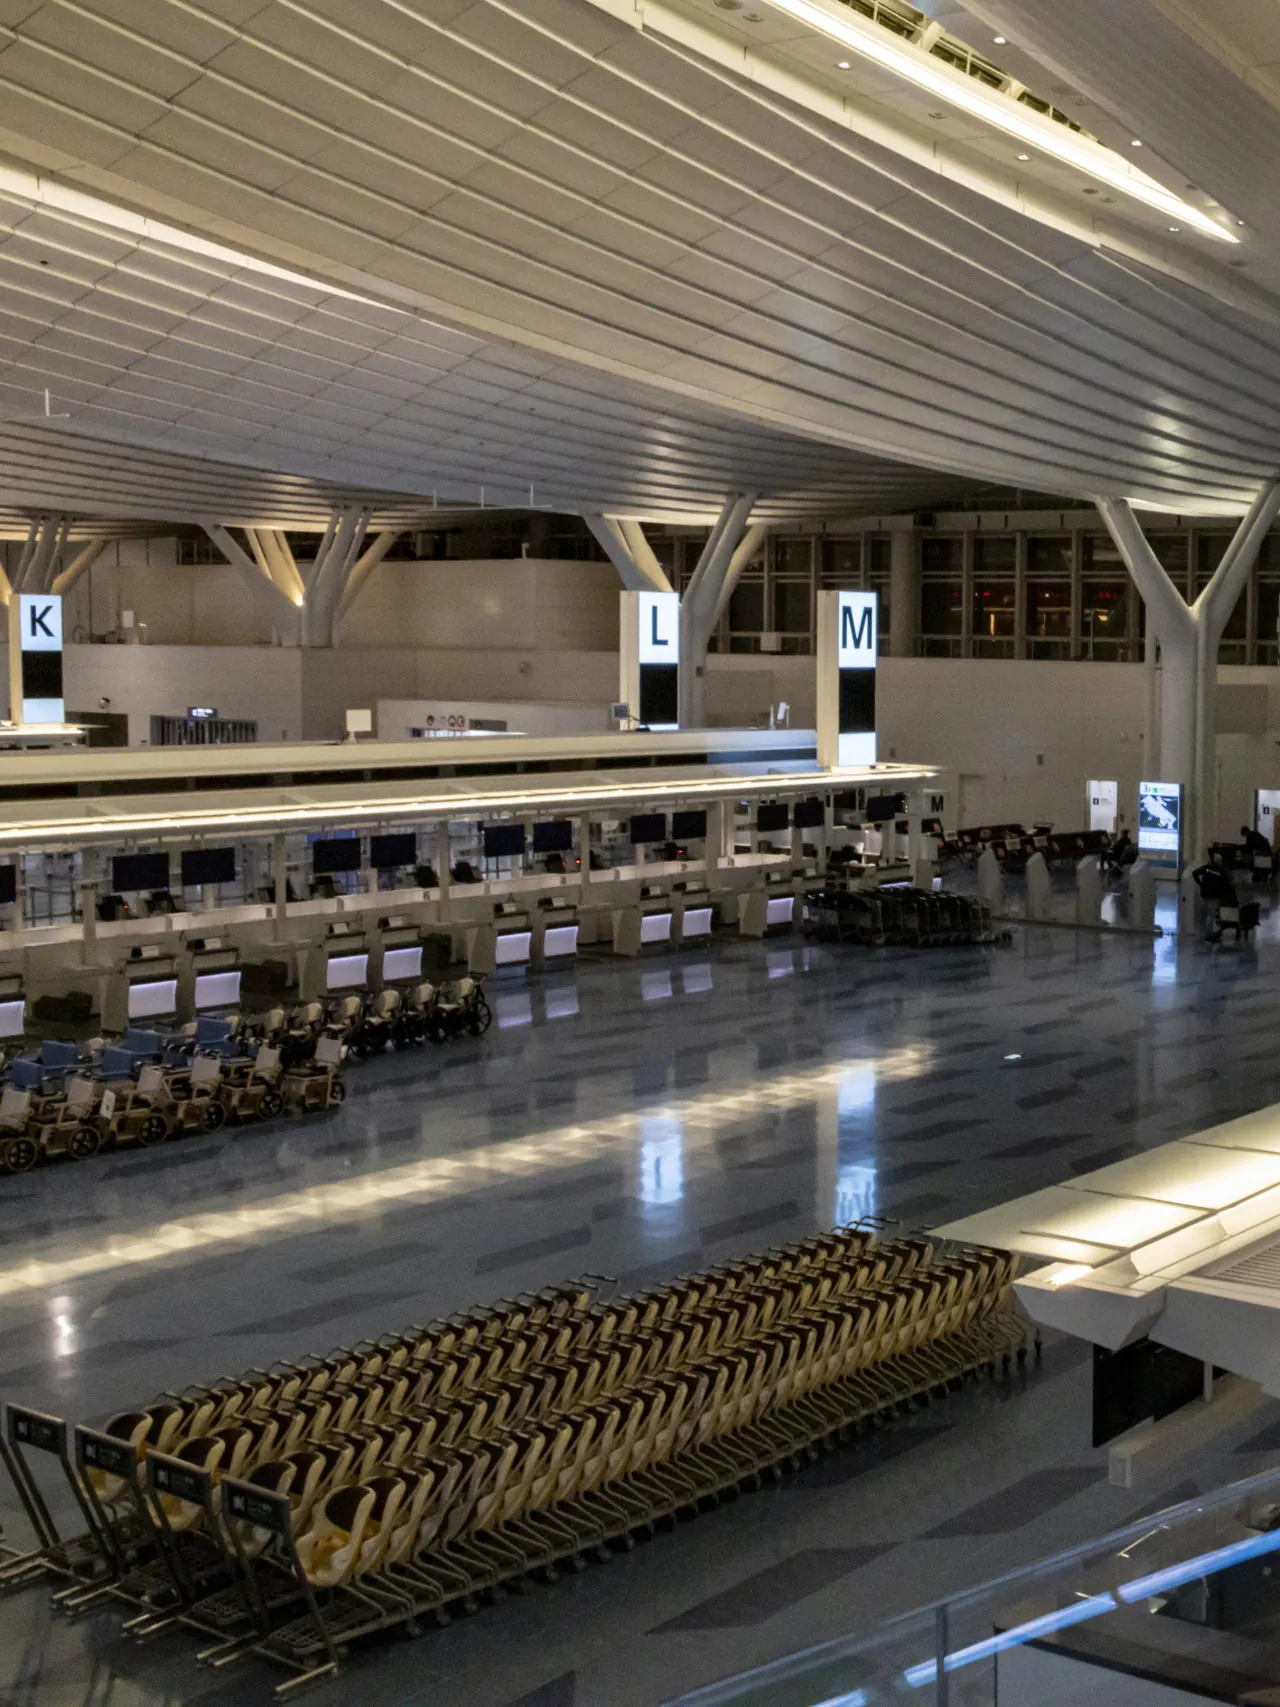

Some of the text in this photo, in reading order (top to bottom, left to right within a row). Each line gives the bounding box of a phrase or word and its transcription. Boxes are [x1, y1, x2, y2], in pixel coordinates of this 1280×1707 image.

[30, 605, 55, 637] K
[651, 605, 669, 646] L
[841, 605, 873, 650] M
[931, 795, 944, 813] M
